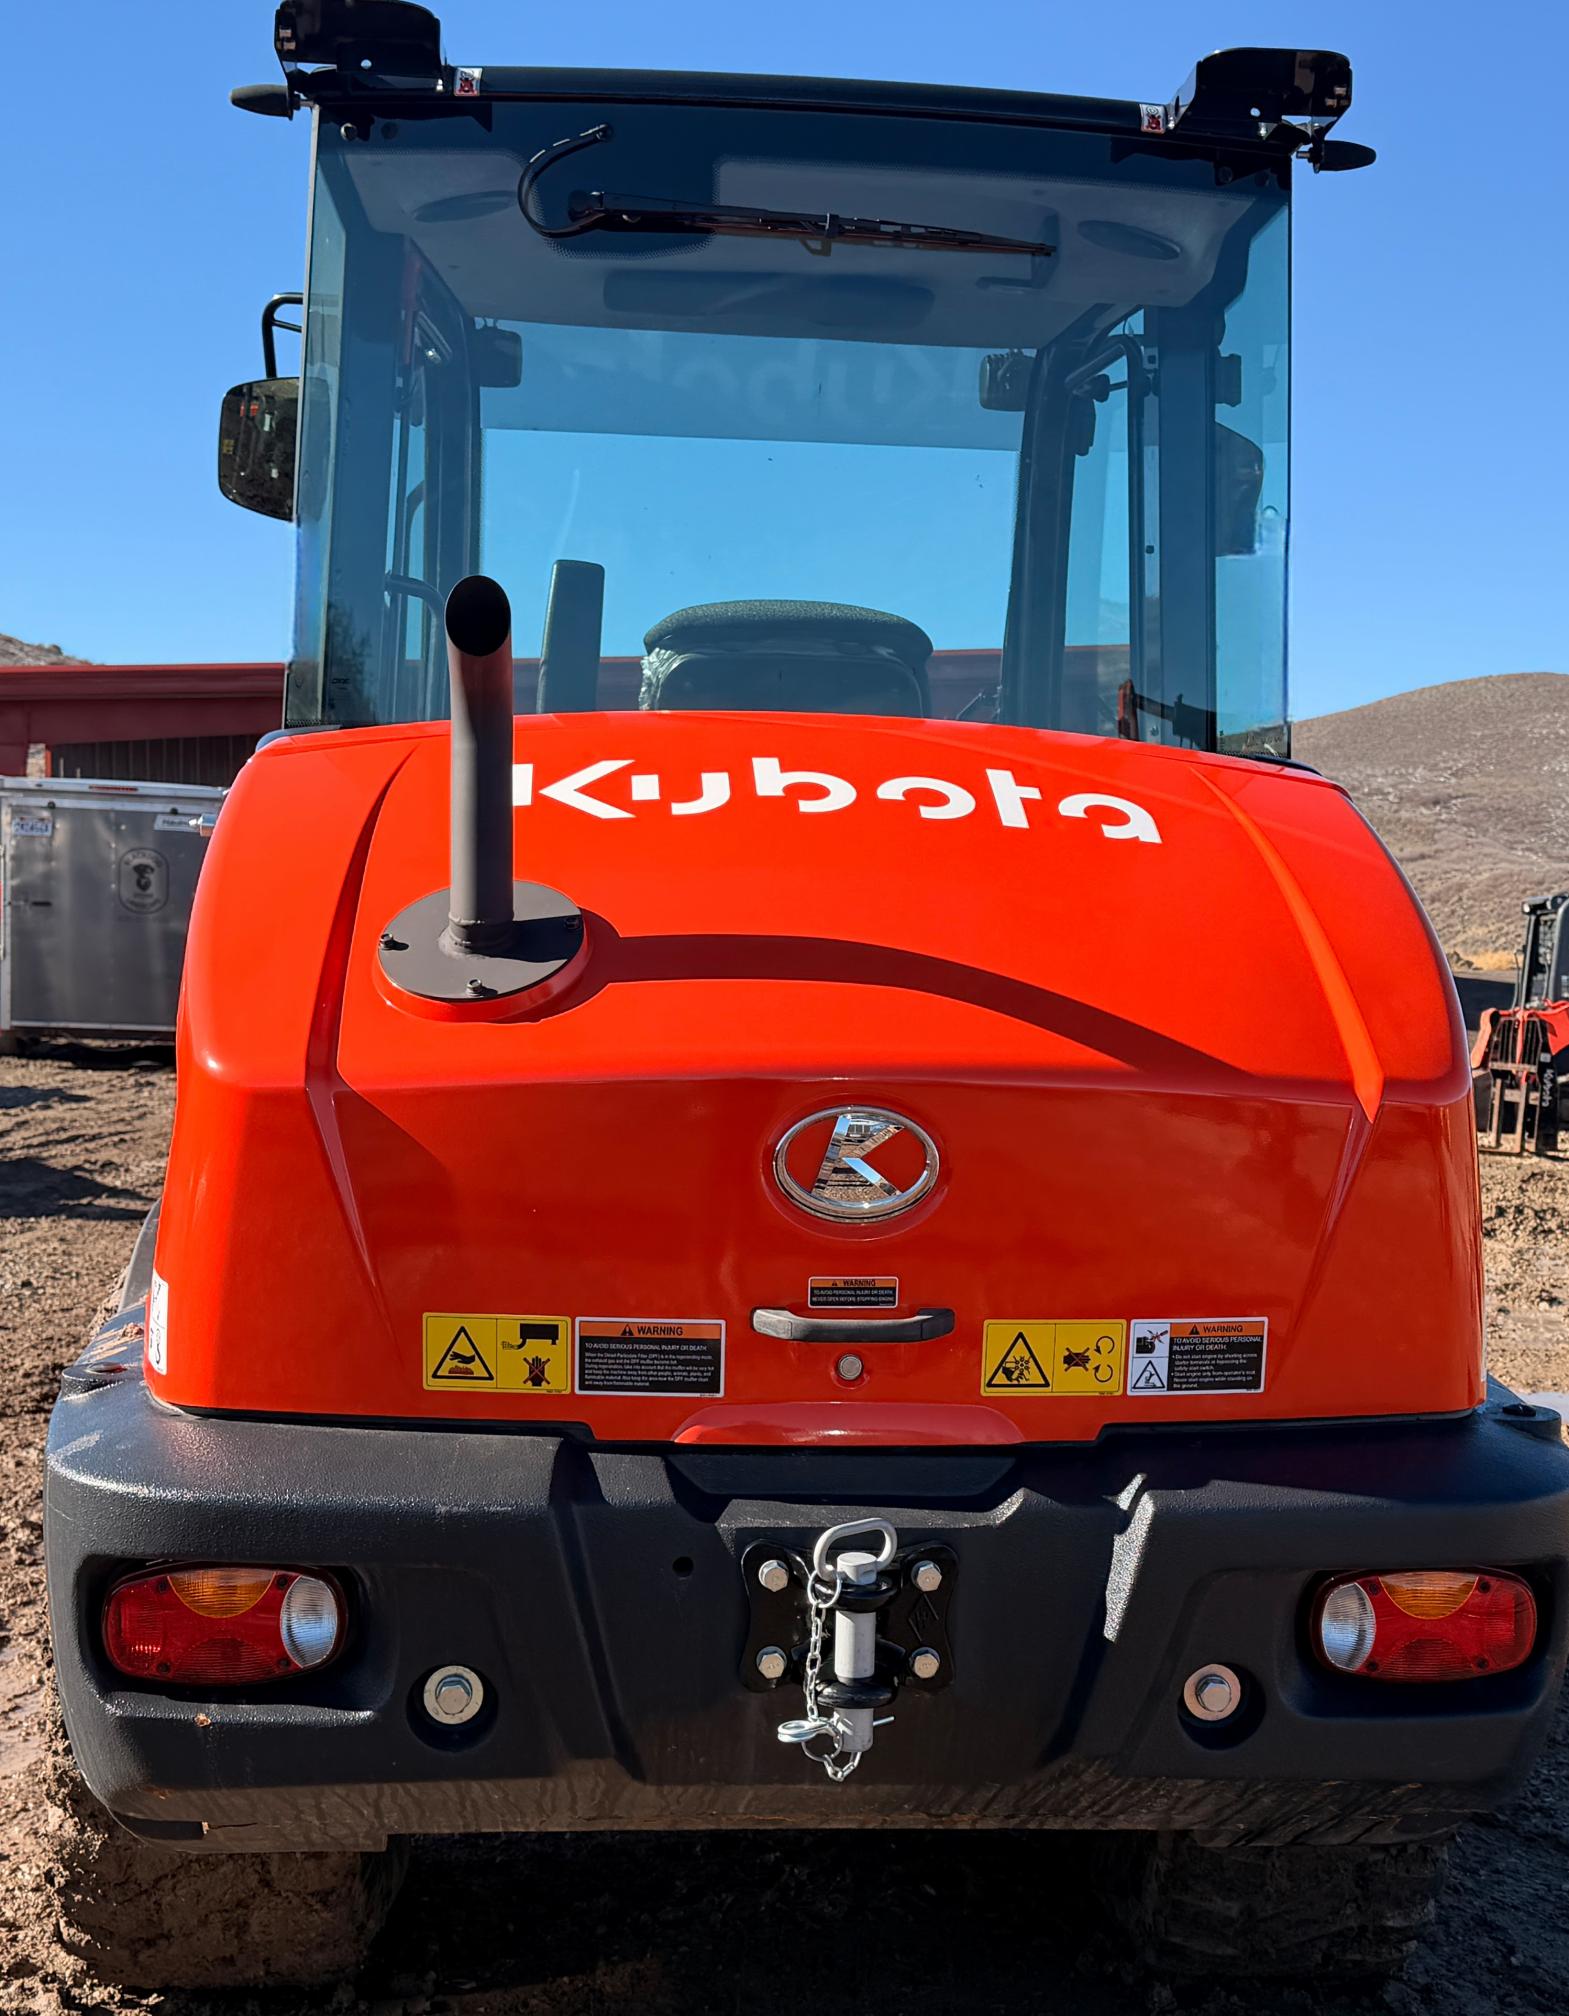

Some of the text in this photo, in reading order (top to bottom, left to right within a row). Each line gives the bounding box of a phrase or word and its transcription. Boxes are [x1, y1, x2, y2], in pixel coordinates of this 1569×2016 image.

[513, 757, 1163, 844] Kubota
[843, 1279, 876, 1287] WARNING
[637, 1326, 684, 1336] WARNING
[1203, 1324, 1244, 1334] WARNING
